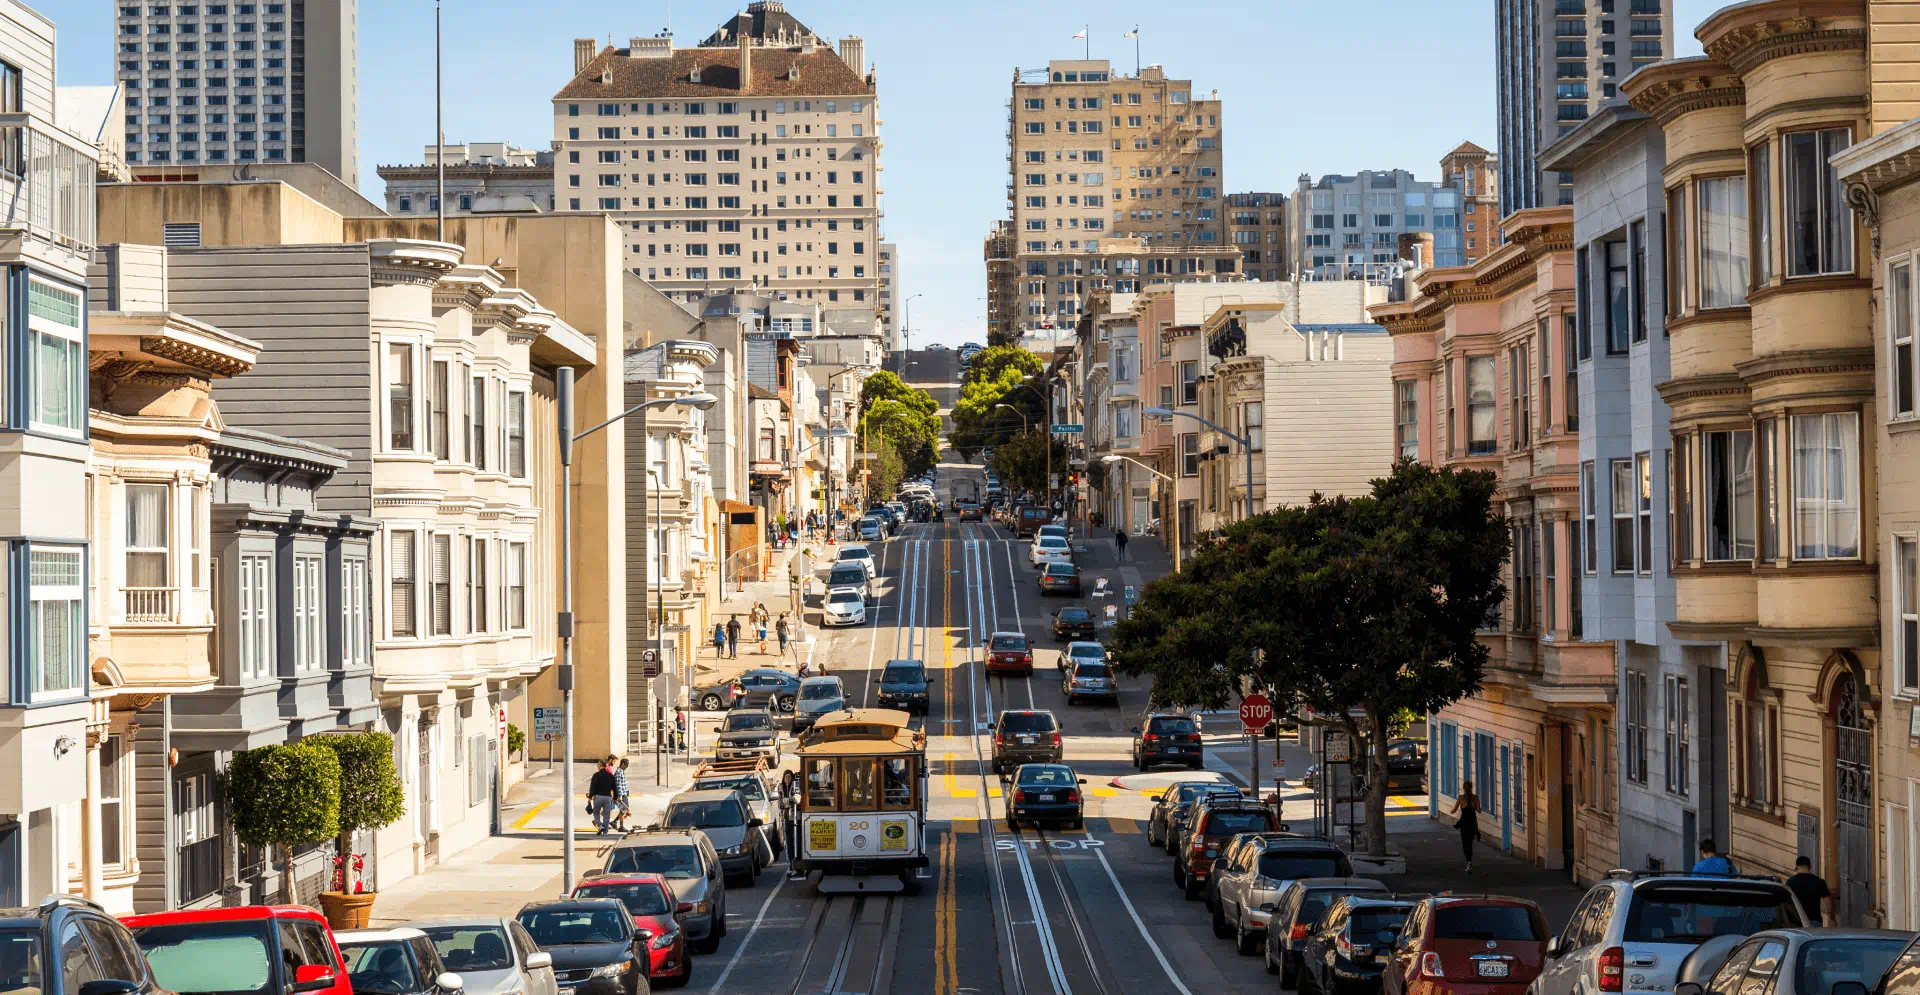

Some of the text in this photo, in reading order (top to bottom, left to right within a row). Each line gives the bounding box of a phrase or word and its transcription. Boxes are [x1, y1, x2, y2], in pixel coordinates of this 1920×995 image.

[535, 709, 542, 717] 2
[1241, 704, 1271, 718] STOP
[849, 821, 870, 831] 20
[996, 839, 1105, 850] STOP
